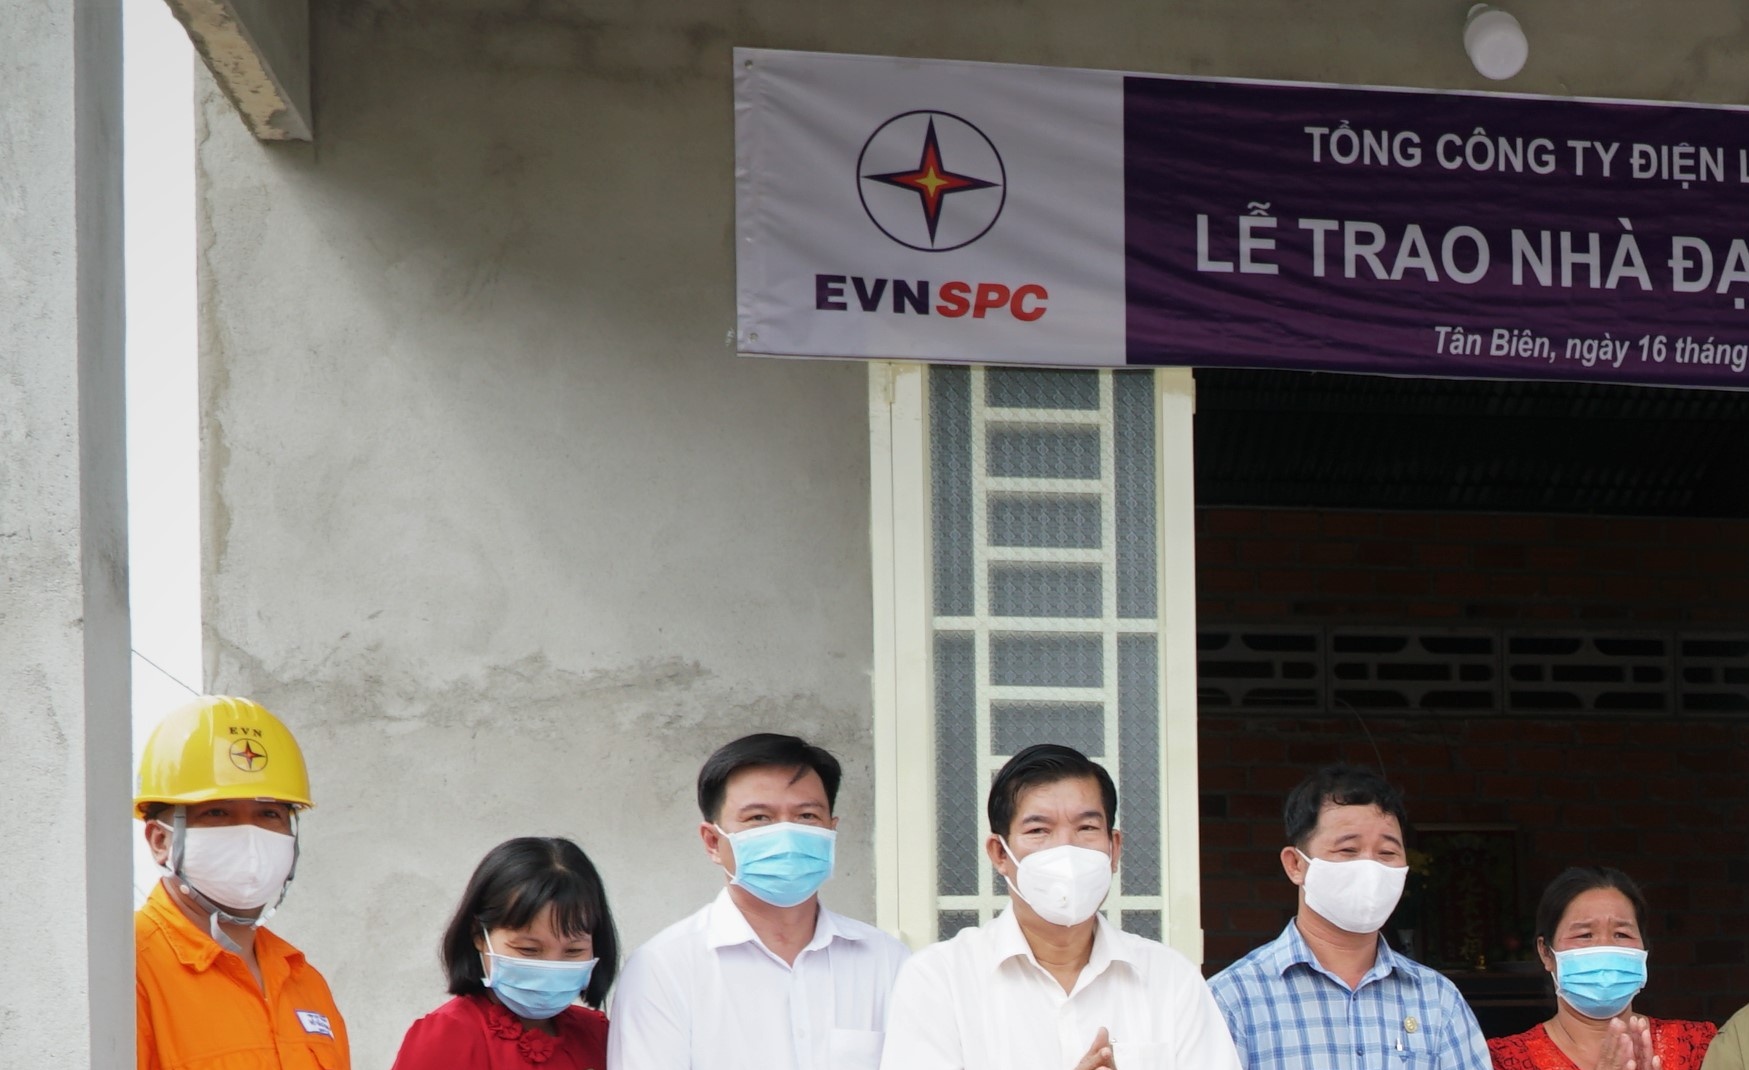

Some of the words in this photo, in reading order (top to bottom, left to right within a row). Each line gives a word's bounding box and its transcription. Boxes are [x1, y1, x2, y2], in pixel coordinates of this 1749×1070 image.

[1305, 119, 1422, 168] TỔNG
[1436, 127, 1556, 175] CÔNG
[1568, 140, 1621, 177] TY
[1630, 142, 1725, 189] ĐIỆN
[1197, 202, 1279, 275] LỄ
[1299, 219, 1489, 284] TRAO
[1512, 218, 1652, 291] NHÀ
[1433, 326, 1482, 357] Tân
[1490, 328, 1556, 364] Biên,
[1565, 337, 1629, 369] ngày
[1638, 335, 1667, 364] 16
[1675, 337, 1748, 373] tháng
[229, 726, 262, 738] EVN
